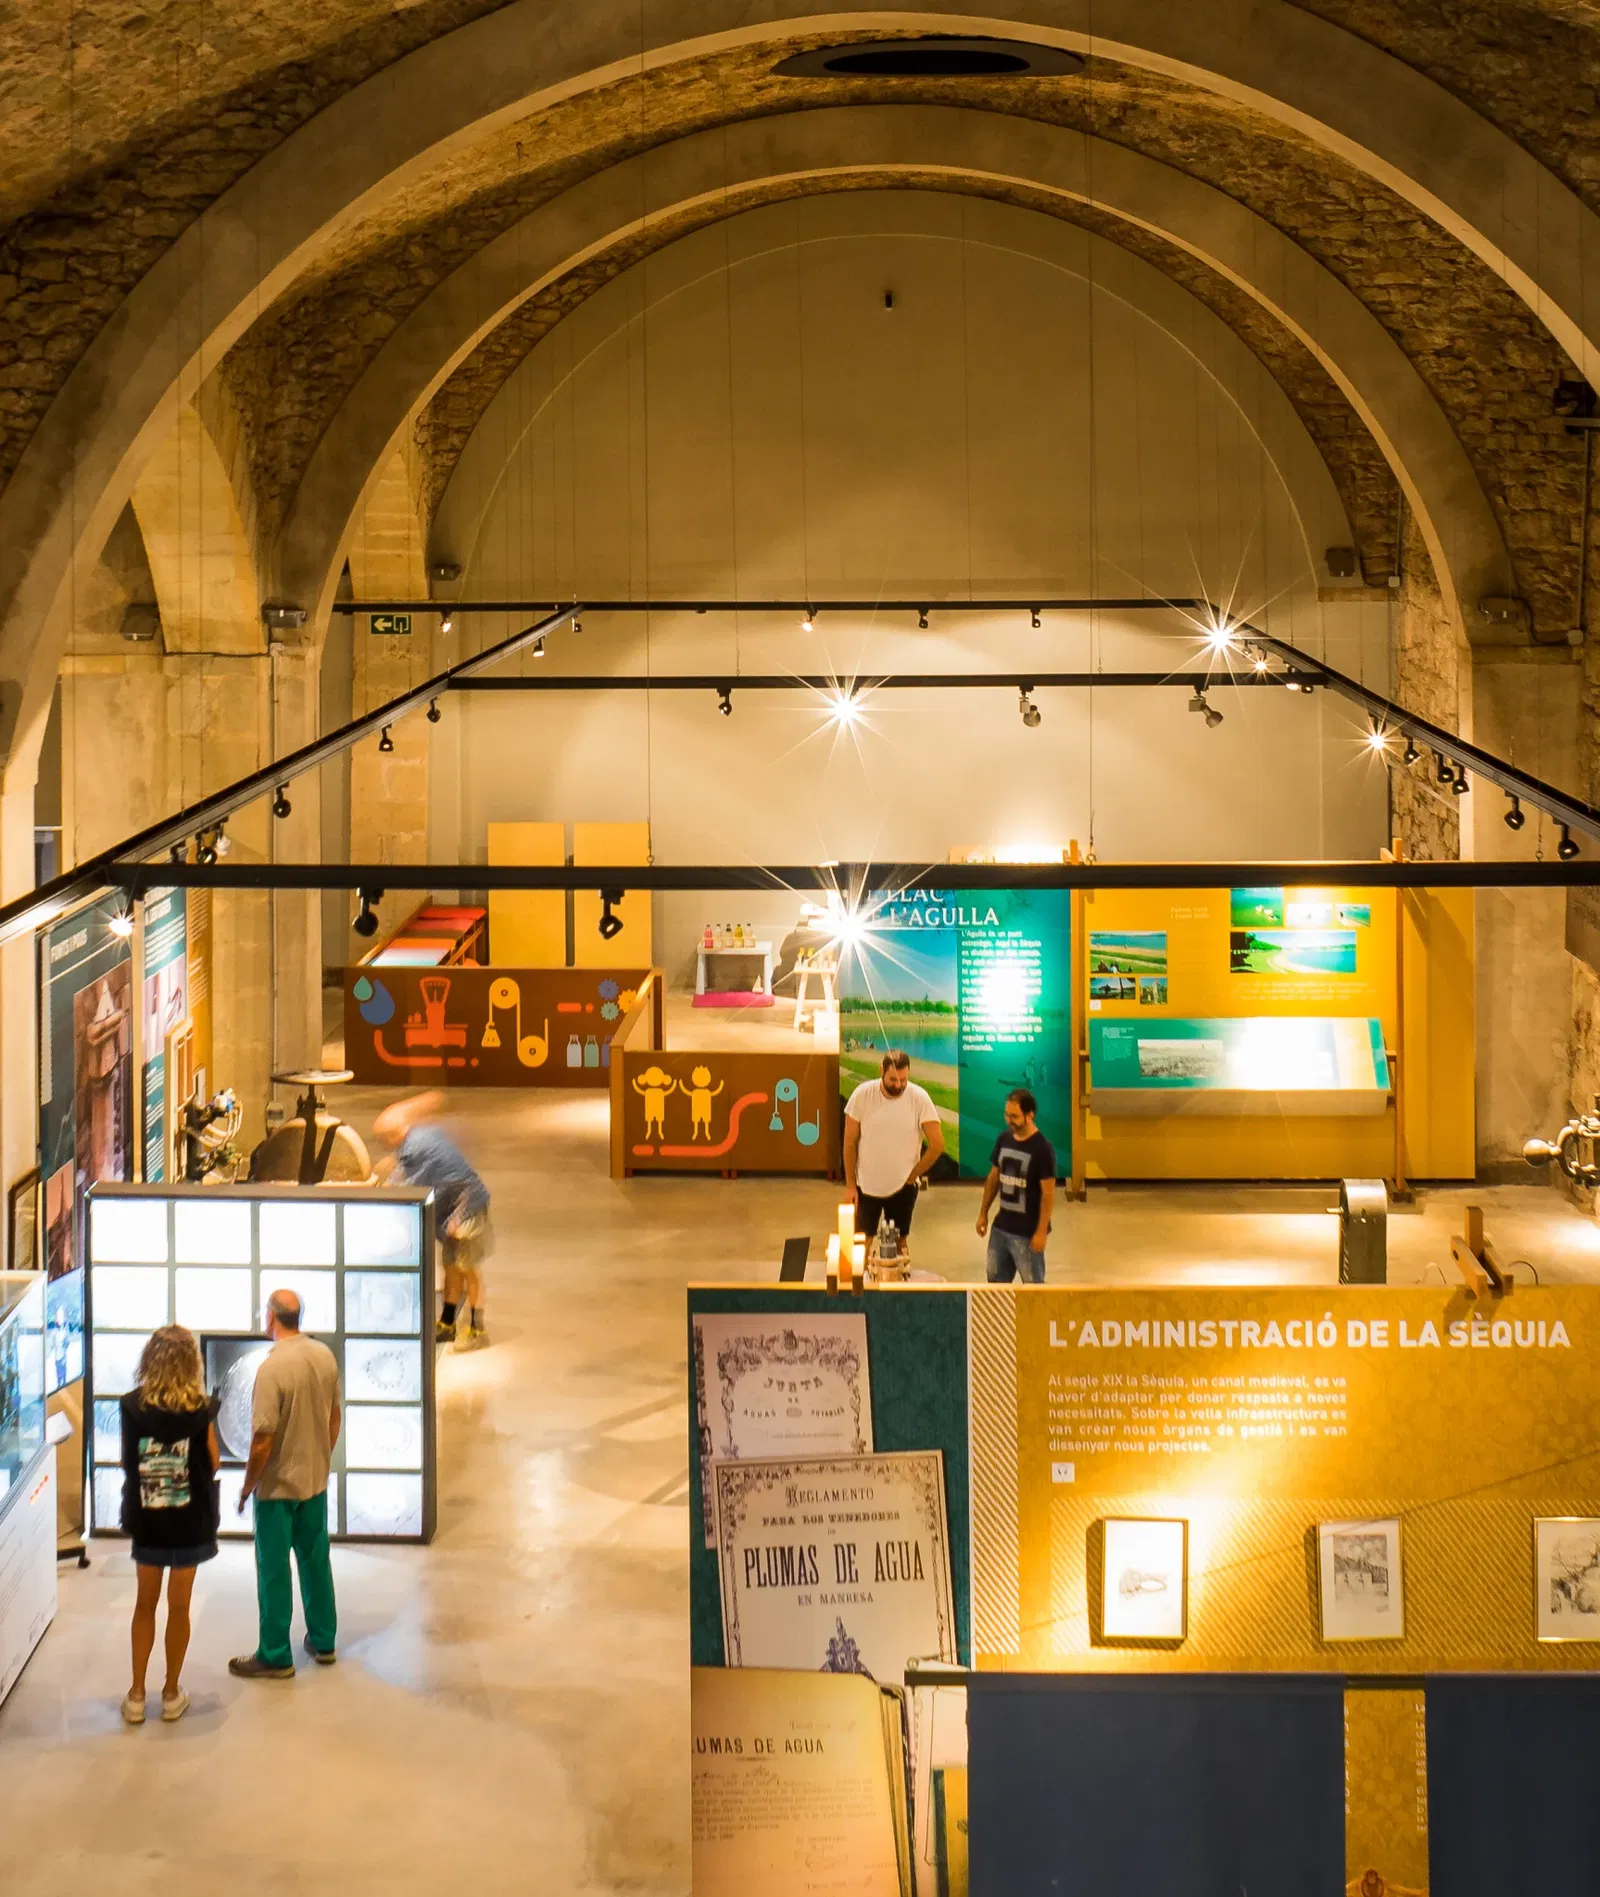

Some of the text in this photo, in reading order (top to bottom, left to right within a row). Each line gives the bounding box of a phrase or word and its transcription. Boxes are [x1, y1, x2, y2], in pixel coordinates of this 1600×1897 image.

[890, 907, 999, 926] L'AGULLA
[1049, 1312, 1571, 1348] L'ADMINISTRACIÓ DE LA SÈQUIA
[1048, 1373, 1346, 1390] Al segle XIX la Sèquia, un canal medieval, es va
[1048, 1390, 1347, 1406] haver d'adaptar per donar resposta a noves
[1048, 1406, 1347, 1420] necessitats. Sobre la vella infraestructura es
[1048, 1424, 1072, 1435] van
[1079, 1424, 1116, 1435] crear
[1123, 1424, 1156, 1435] nous
[1162, 1423, 1211, 1438] òrgans
[1216, 1424, 1234, 1436] de
[1240, 1422, 1283, 1440] gestió
[1300, 1426, 1317, 1436] es
[1323, 1425, 1347, 1436] van
[1049, 1438, 1212, 1455] dissenyar nous projectes.
[762, 1516, 796, 1527] PARA
[828, 1511, 900, 1524] TENEDORES
[744, 1540, 926, 1589] PLUMAS DE AGUA
[797, 1592, 874, 1607] EN MANRESA
[754, 1738, 776, 1754] DE
[784, 1738, 825, 1754] AGUA
